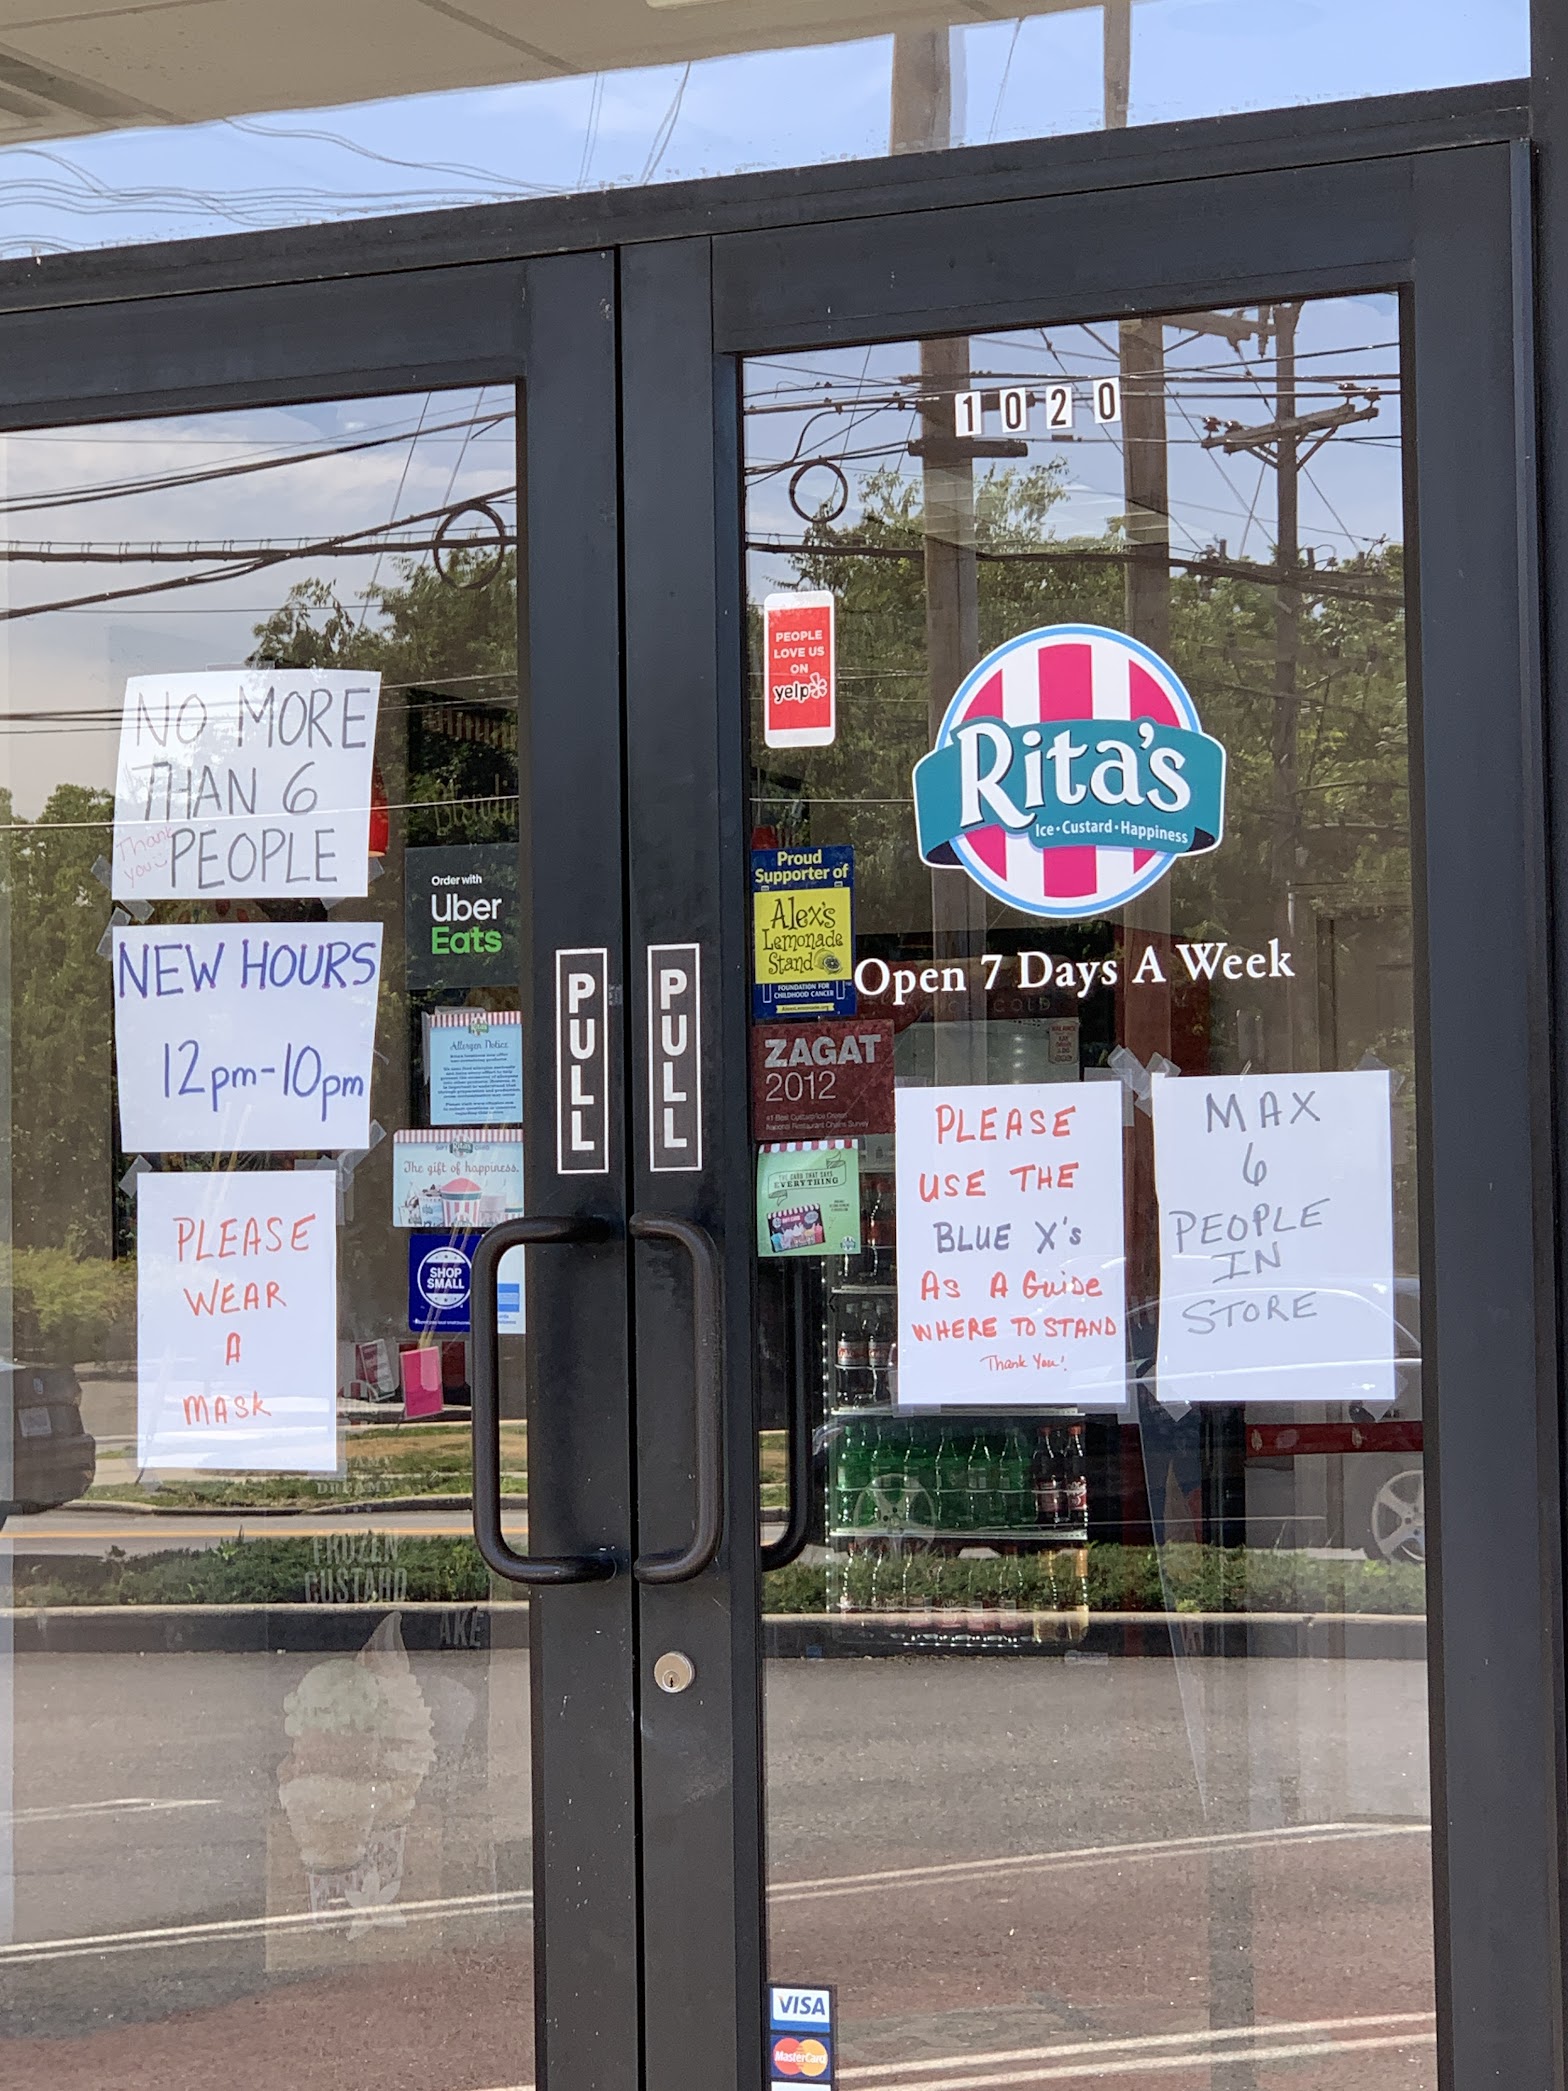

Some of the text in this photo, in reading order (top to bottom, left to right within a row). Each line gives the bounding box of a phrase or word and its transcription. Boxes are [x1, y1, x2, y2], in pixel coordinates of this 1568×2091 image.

[962, 382, 1116, 433] 1020
[775, 630, 823, 643] PEOPLE
[773, 645, 825, 659] LOVE US
[790, 663, 809, 675] ON
[774, 683, 810, 702] yelp
[135, 686, 372, 750] NO MORE
[956, 721, 1192, 829] Rita's
[132, 760, 318, 823] THAN 6
[1035, 819, 1189, 845] Ice Custard Happiness
[171, 827, 338, 890] PEOPLE
[777, 849, 822, 866] Proud
[431, 873, 482, 887] Order with
[755, 863, 849, 885] Supporter of
[431, 893, 503, 922] Uber
[770, 896, 836, 931] Alex's
[431, 926, 503, 955] Eats
[762, 929, 844, 951] Lemonade
[117, 938, 378, 999] NEW HOURS
[768, 951, 814, 975] Stand
[853, 956, 967, 1006] Open
[980, 953, 1003, 991] 7
[1017, 950, 1118, 999] Days
[1133, 955, 1167, 984] A
[1176, 938, 1296, 981] Week
[774, 989, 834, 1000] CHILDHOOD CANCER
[778, 982, 830, 992] FOUNDATION FOR
[568, 973, 596, 1151] PULL
[659, 968, 688, 1149] PULL
[764, 1033, 881, 1069] ZAGAT
[163, 1038, 364, 1122] 12pm-10pm
[765, 1070, 836, 1102] 2012
[935, 1103, 1077, 1145] PLEASE
[1206, 1090, 1322, 1133] MAX
[404, 1160, 520, 1176] The gift of happiness.
[790, 1172, 804, 1180] CARD
[805, 1171, 819, 1179] THAT
[1243, 1142, 1268, 1187] 6
[774, 1176, 839, 1188] EVERYTHING
[918, 1161, 1079, 1203] USE THE
[172, 1213, 317, 1263] PLEASE
[933, 1216, 1082, 1254] BLUE X's
[1168, 1197, 1332, 1254] PEOPLE
[429, 1267, 463, 1279] SHOP
[1211, 1241, 1282, 1284] IN
[183, 1278, 288, 1317] WEAR
[426, 1278, 466, 1290] SMALL
[989, 1271, 1009, 1298] A
[912, 1314, 1118, 1342] WHERE TO STAND
[1180, 1291, 1319, 1336] STORE
[224, 1331, 242, 1366] A
[979, 1352, 1068, 1373] Thank You!
[777, 1995, 827, 2016] VISA
[773, 2050, 828, 2064] MasterCard
